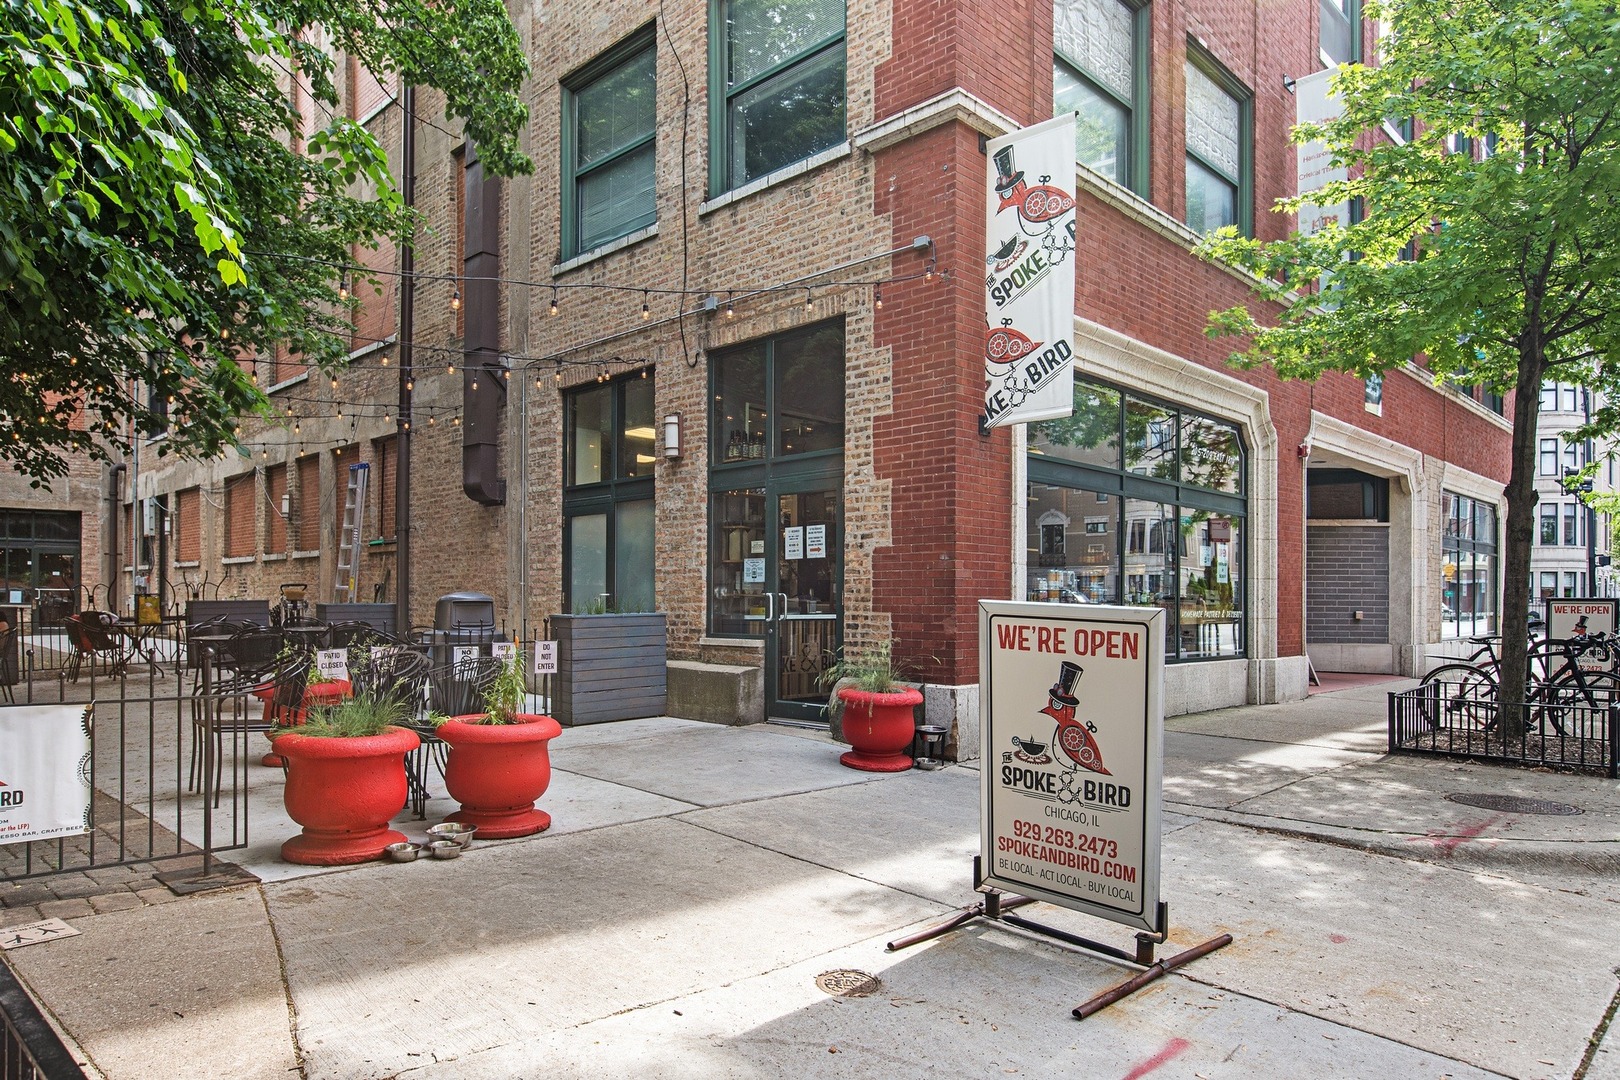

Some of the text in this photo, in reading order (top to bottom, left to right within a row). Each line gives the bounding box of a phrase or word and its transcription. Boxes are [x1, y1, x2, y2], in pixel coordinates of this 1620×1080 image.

[986, 274, 996, 289] THE
[991, 249, 1048, 307] SPOKE
[984, 389, 1010, 423] KE
[1025, 338, 1072, 386] BIRD
[1554, 605, 1609, 614] WE'RE OPEN
[997, 624, 1139, 660] WE'RE OPEN
[1002, 752, 1012, 763] THE
[1002, 766, 1056, 795] SPOKE
[1084, 779, 1131, 808] BIRD
[1044, 805, 1100, 827] CHICAGO, IL
[1013, 819, 1118, 859] 929.263.2473
[998, 835, 1136, 884] SPOKEANDBIRD.COM
[999, 858, 1008, 869] BE
[1010, 860, 1034, 877] LOCAL
[1040, 869, 1054, 882] ACT
[1056, 872, 1082, 889] LOCAL
[1088, 881, 1105, 895] BUY
[1107, 885, 1135, 903] LOCAL
